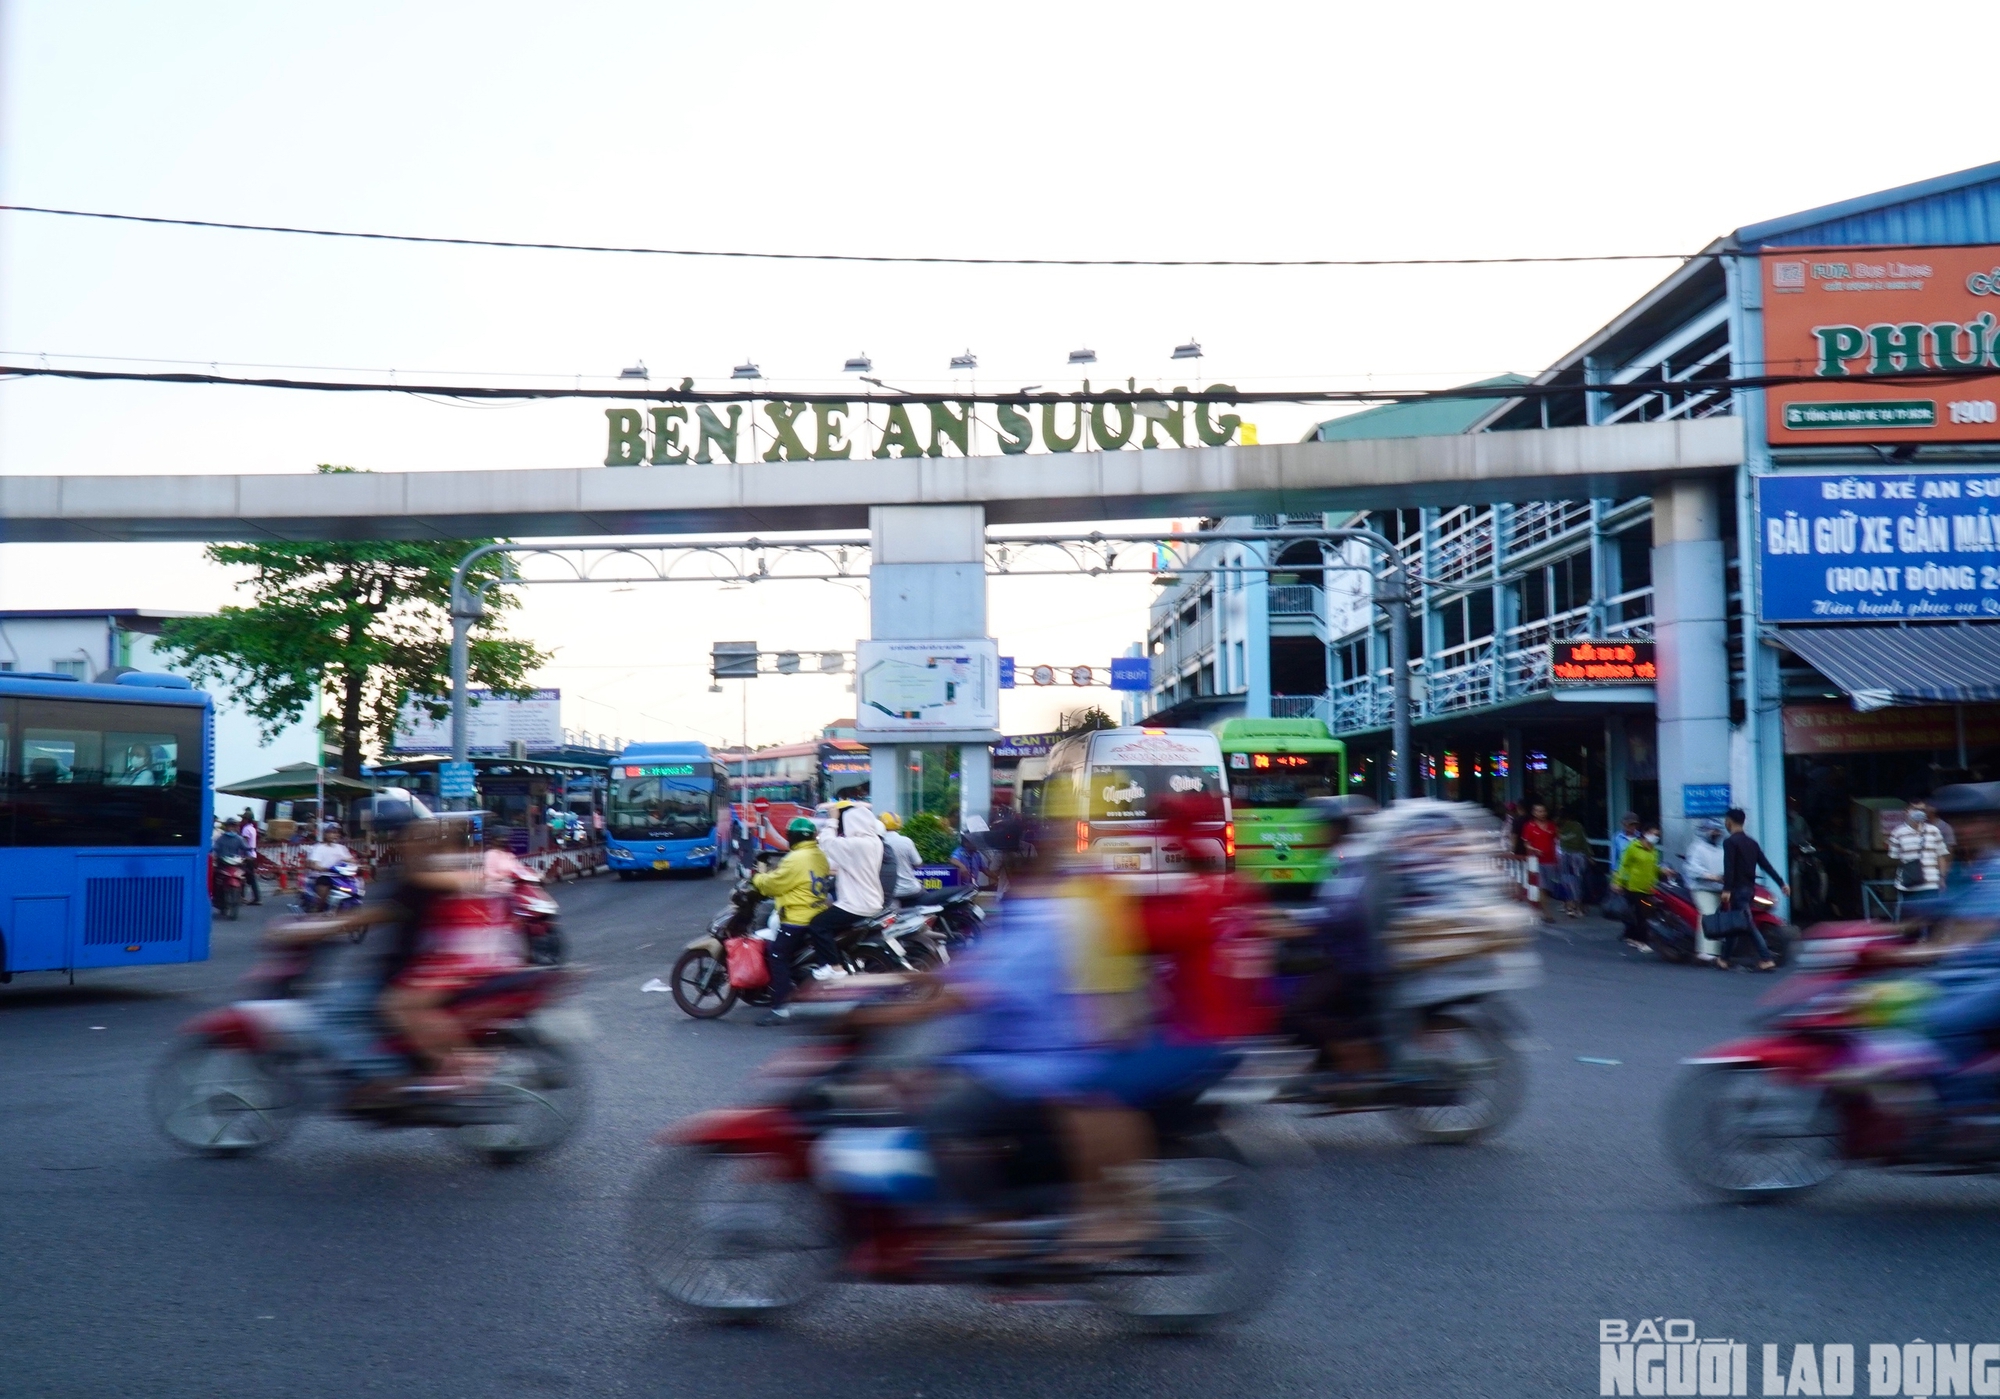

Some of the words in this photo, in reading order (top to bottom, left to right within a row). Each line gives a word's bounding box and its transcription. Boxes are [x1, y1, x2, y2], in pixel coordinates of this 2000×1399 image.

[1811, 262, 1852, 279] FUTA
[1853, 263, 1886, 278] Bus
[1887, 261, 1933, 278] Lines
[1811, 310, 2000, 376] PHƯ
[604, 376, 743, 467] BẾN
[762, 399, 853, 462] XE
[872, 398, 973, 458] AN
[997, 376, 1241, 455] SƯƠNG
[1946, 400, 1997, 423] 1900
[1821, 476, 1876, 499] BẾN
[1881, 480, 1916, 499] XE
[1921, 481, 1960, 498] AN
[1767, 510, 1810, 554] BÃI
[1814, 509, 1858, 553] GIỮ
[1861, 516, 1894, 553] XE
[1825, 566, 1901, 597] (HOẠT
[1904, 561, 1976, 596] ĐỘNG
